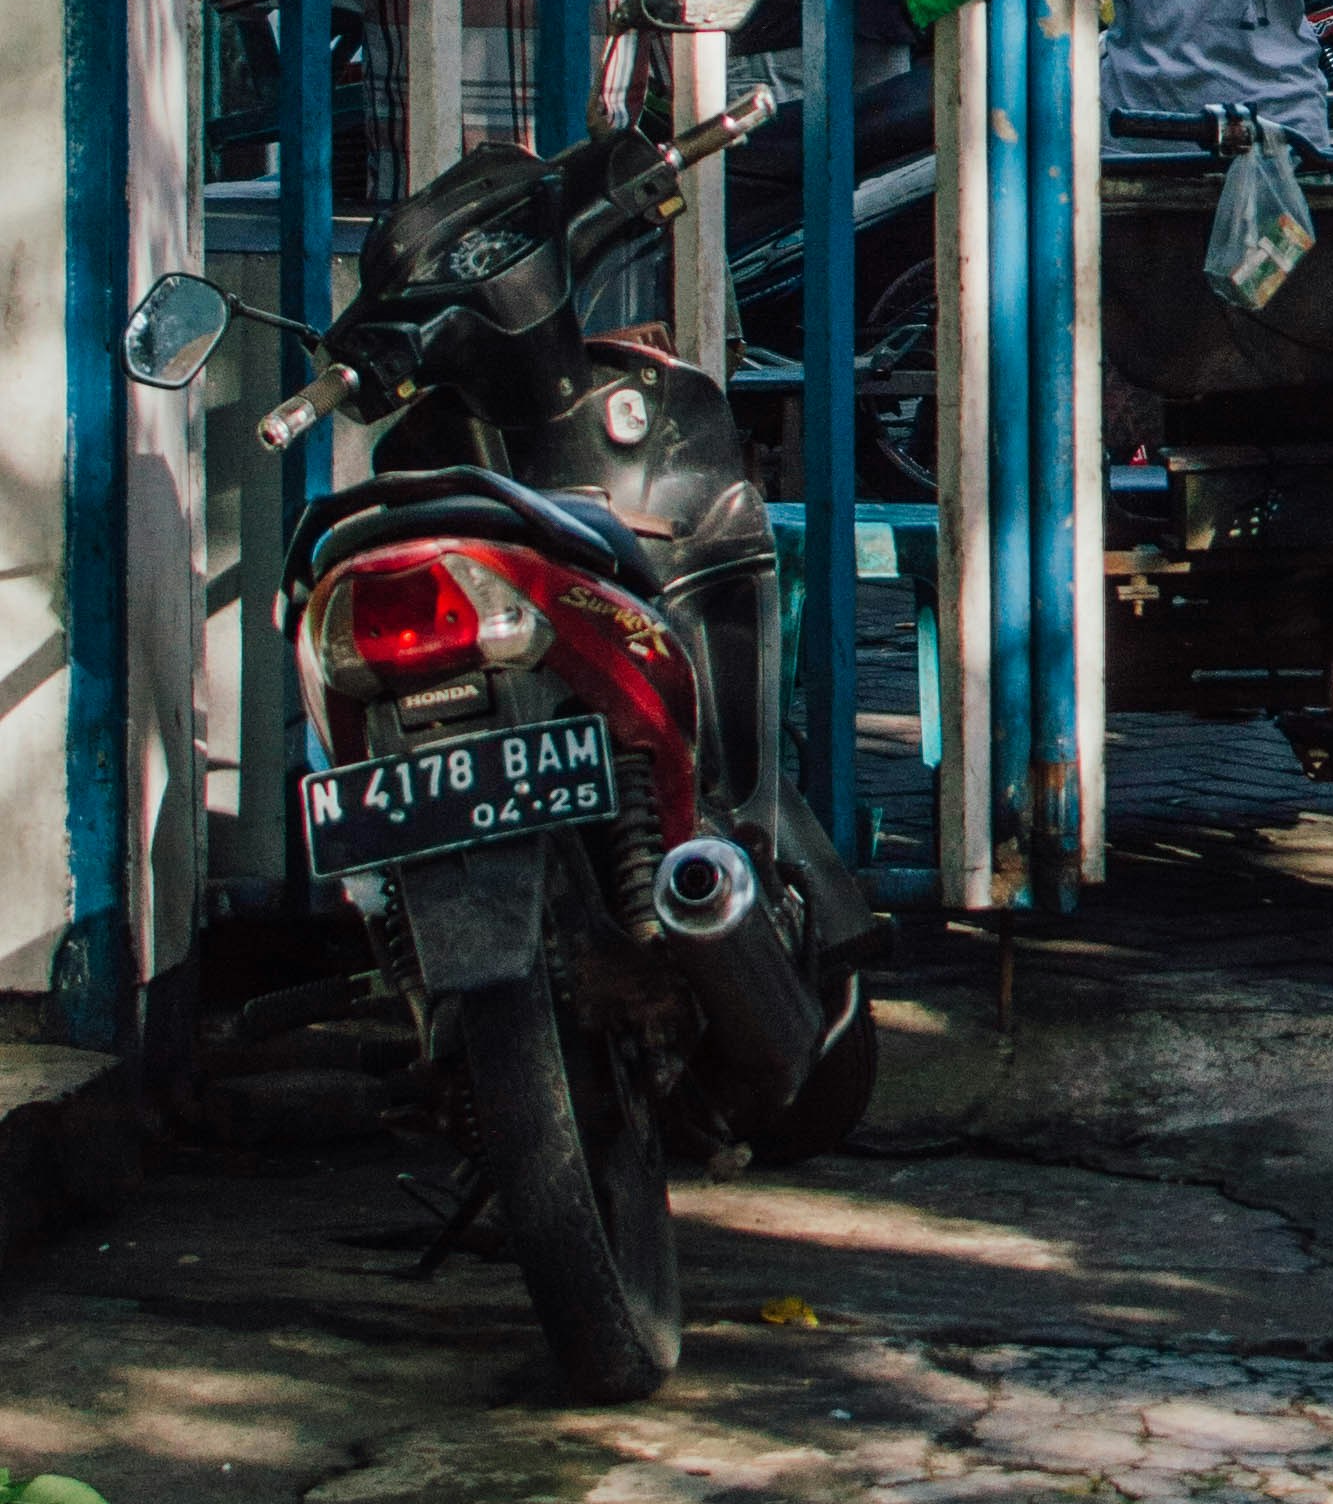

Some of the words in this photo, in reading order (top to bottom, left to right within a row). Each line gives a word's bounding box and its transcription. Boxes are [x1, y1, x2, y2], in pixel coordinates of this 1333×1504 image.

[401, 683, 480, 709] HONDA
[311, 778, 343, 826] N
[363, 748, 473, 811] 4178
[502, 725, 599, 779] BAM
